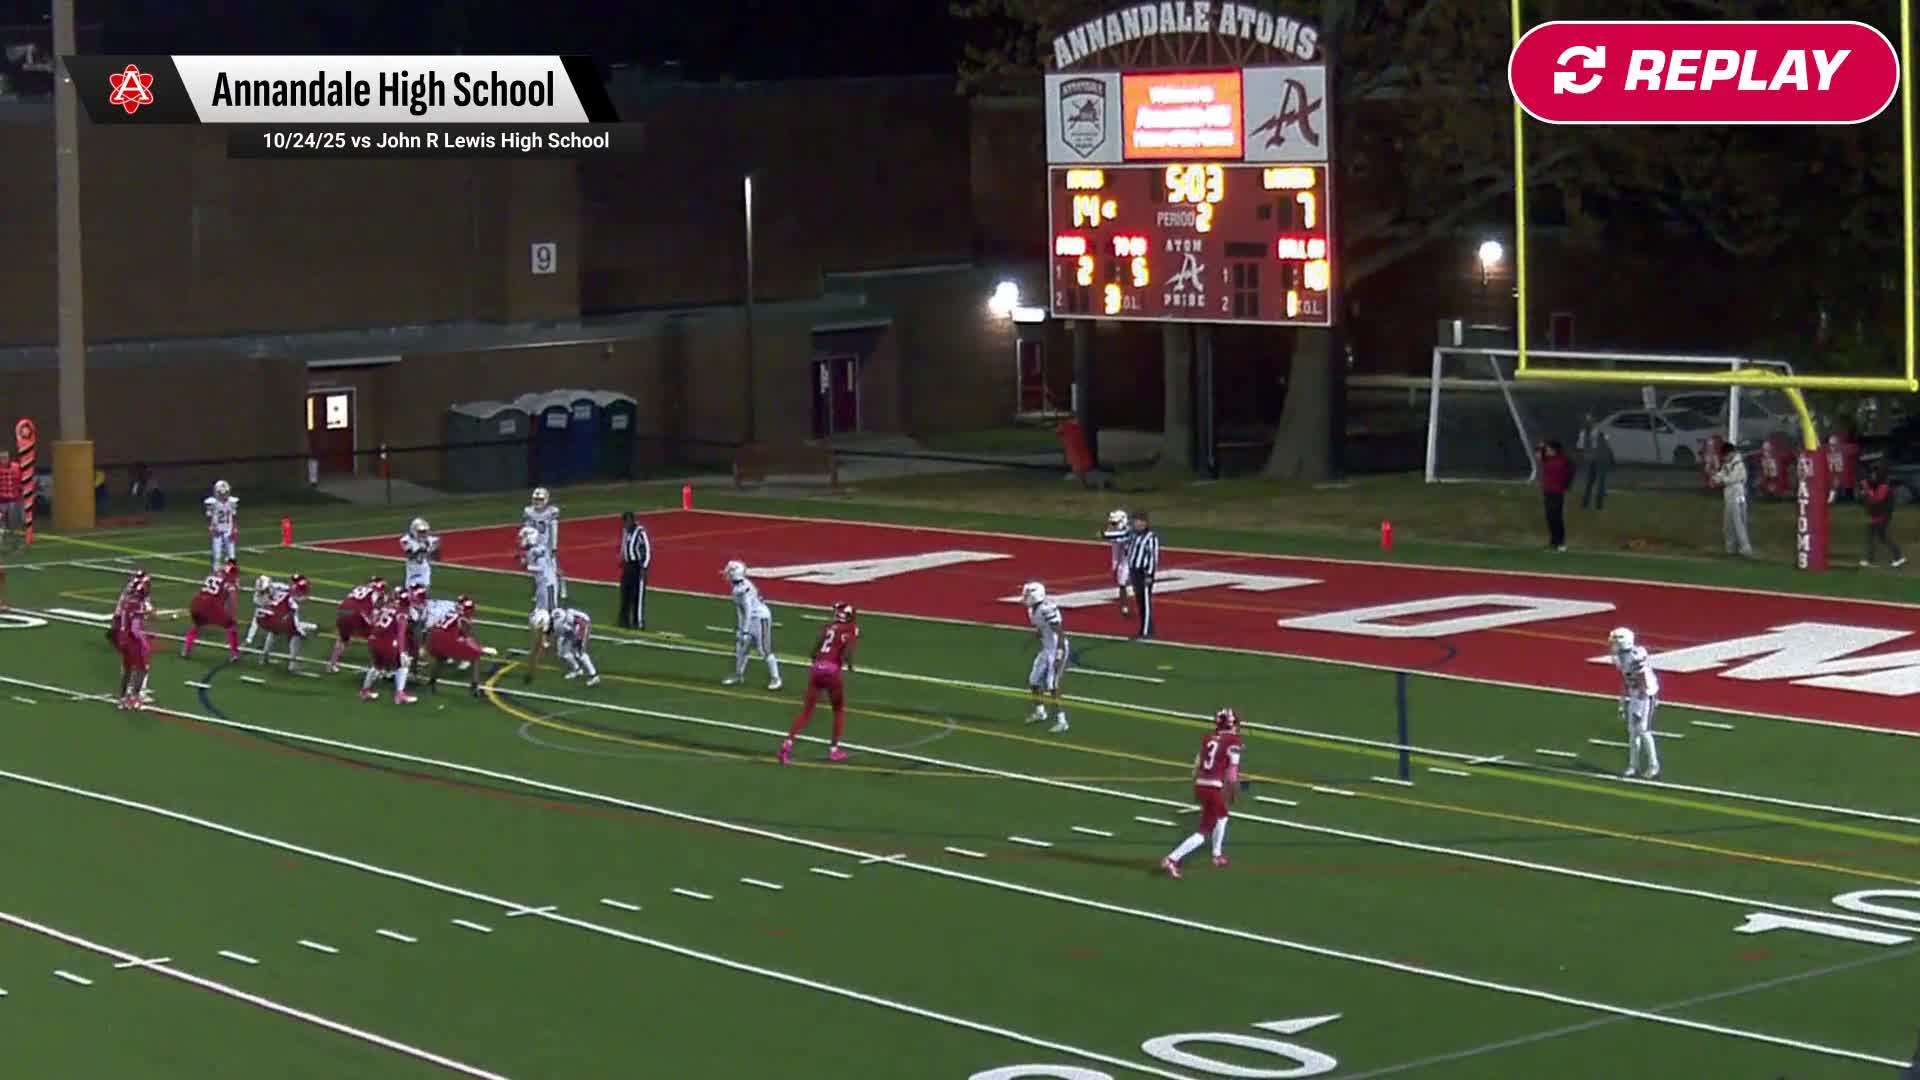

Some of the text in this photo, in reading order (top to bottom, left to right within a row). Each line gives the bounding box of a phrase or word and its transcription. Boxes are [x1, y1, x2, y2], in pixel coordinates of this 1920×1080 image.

[1053, 1, 1318, 69] ANNANDALE ATOMS
[1165, 164, 1224, 203] 5:03
[1073, 194, 1100, 228] 14
[1157, 210, 1195, 227] PERIOD
[1195, 202, 1213, 233] 2
[1297, 191, 1316, 229] 7
[537, 246, 551, 271] 9
[1165, 239, 1203, 252] ATOM
[1077, 255, 1094, 286] 2
[1131, 256, 1149, 287] 5
[1105, 283, 1121, 315] 3
[1163, 293, 1206, 307] PRIDE
[1221, 296, 1230, 312] 2
[1797, 481, 1810, 569] ATOMS
[201, 575, 224, 595] 55
[820, 629, 835, 653] 2
[1203, 740, 1219, 770] 3
